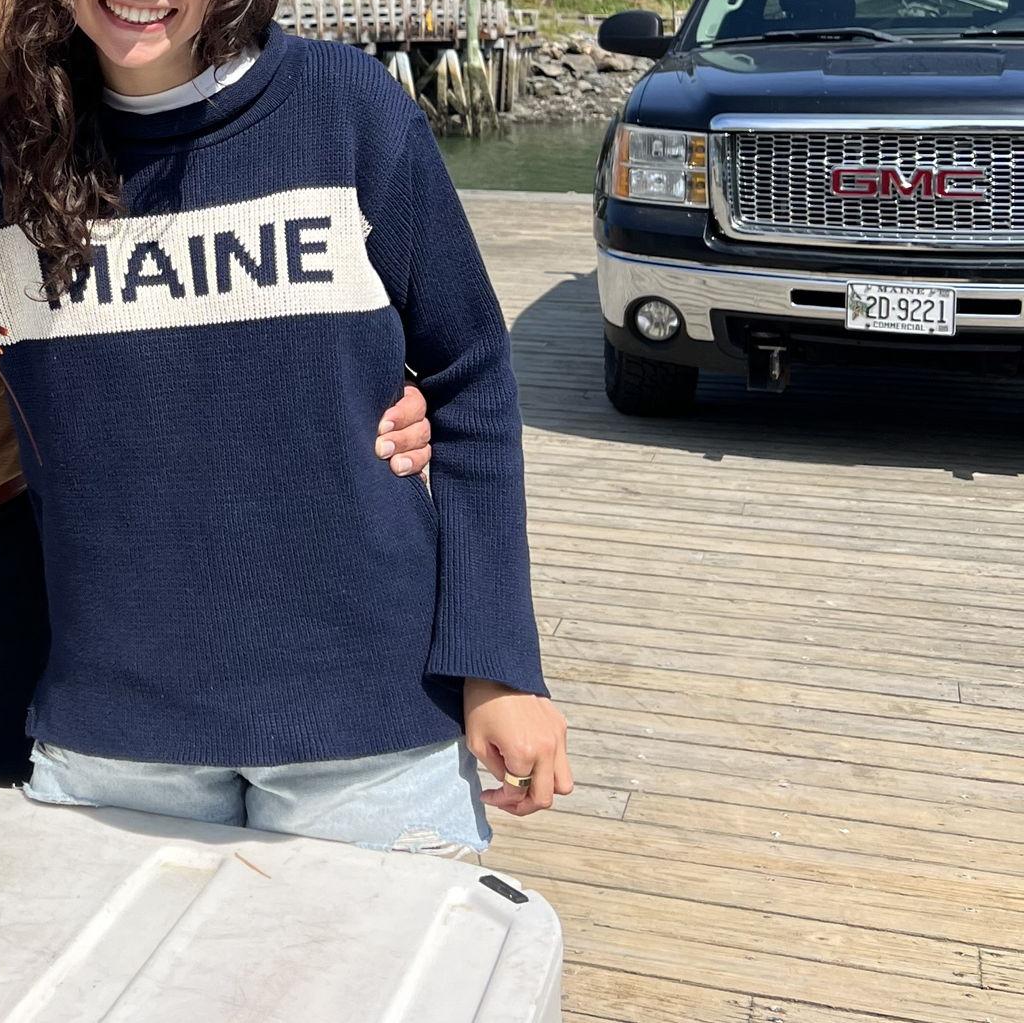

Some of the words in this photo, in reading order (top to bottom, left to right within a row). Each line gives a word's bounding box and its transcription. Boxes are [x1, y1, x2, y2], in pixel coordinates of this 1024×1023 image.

[829, 164, 987, 200] GMC
[877, 286, 925, 295] MAINE
[873, 321, 925, 331] COMMERCIAL
